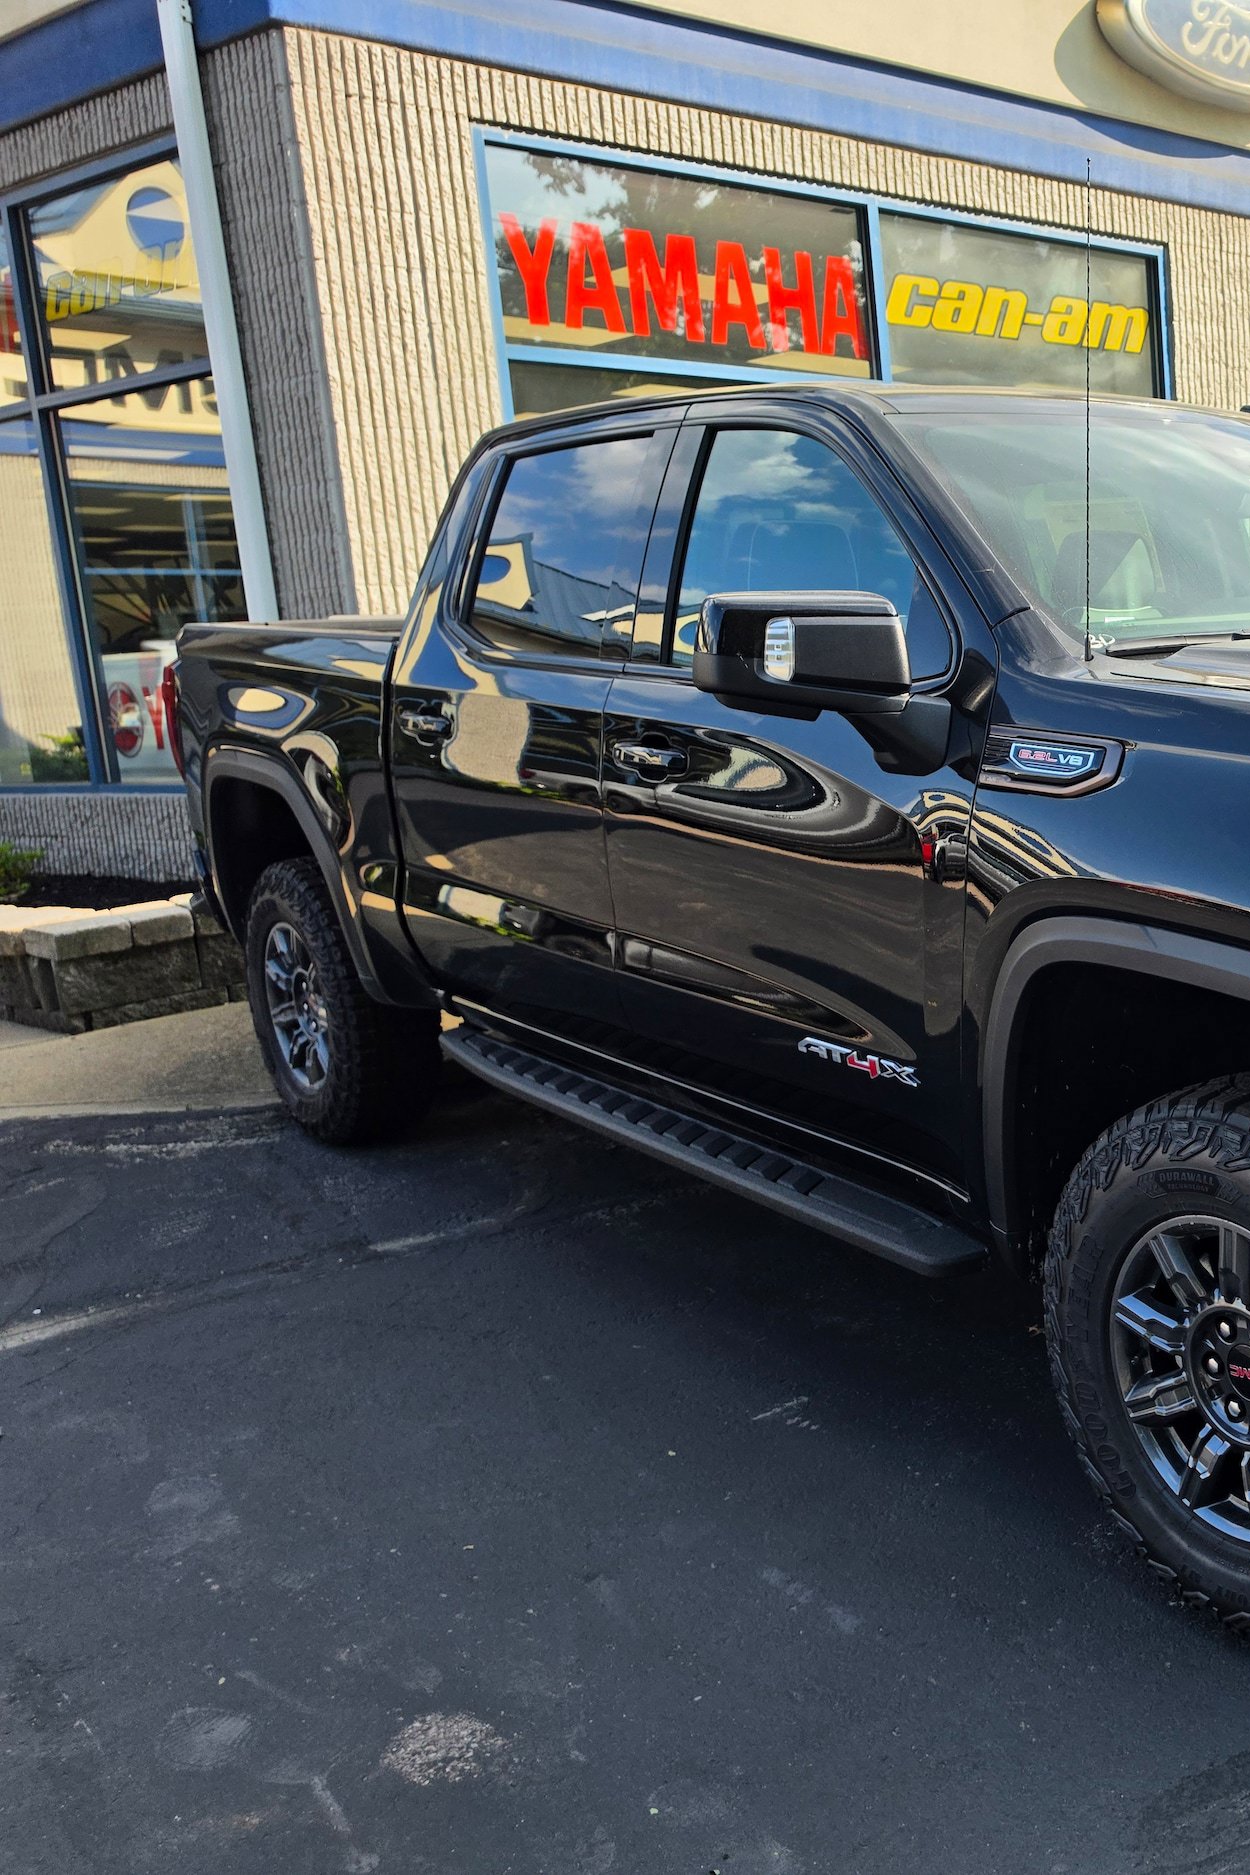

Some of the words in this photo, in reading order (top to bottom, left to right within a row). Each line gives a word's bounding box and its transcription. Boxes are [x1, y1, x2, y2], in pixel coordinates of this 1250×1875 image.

[499, 212, 870, 360] YAMAHA
[885, 273, 1149, 354] can-am
[1058, 753, 1084, 766] V8
[798, 1037, 921, 1087] AT4X
[1158, 1171, 1214, 1186] DURAWALL
